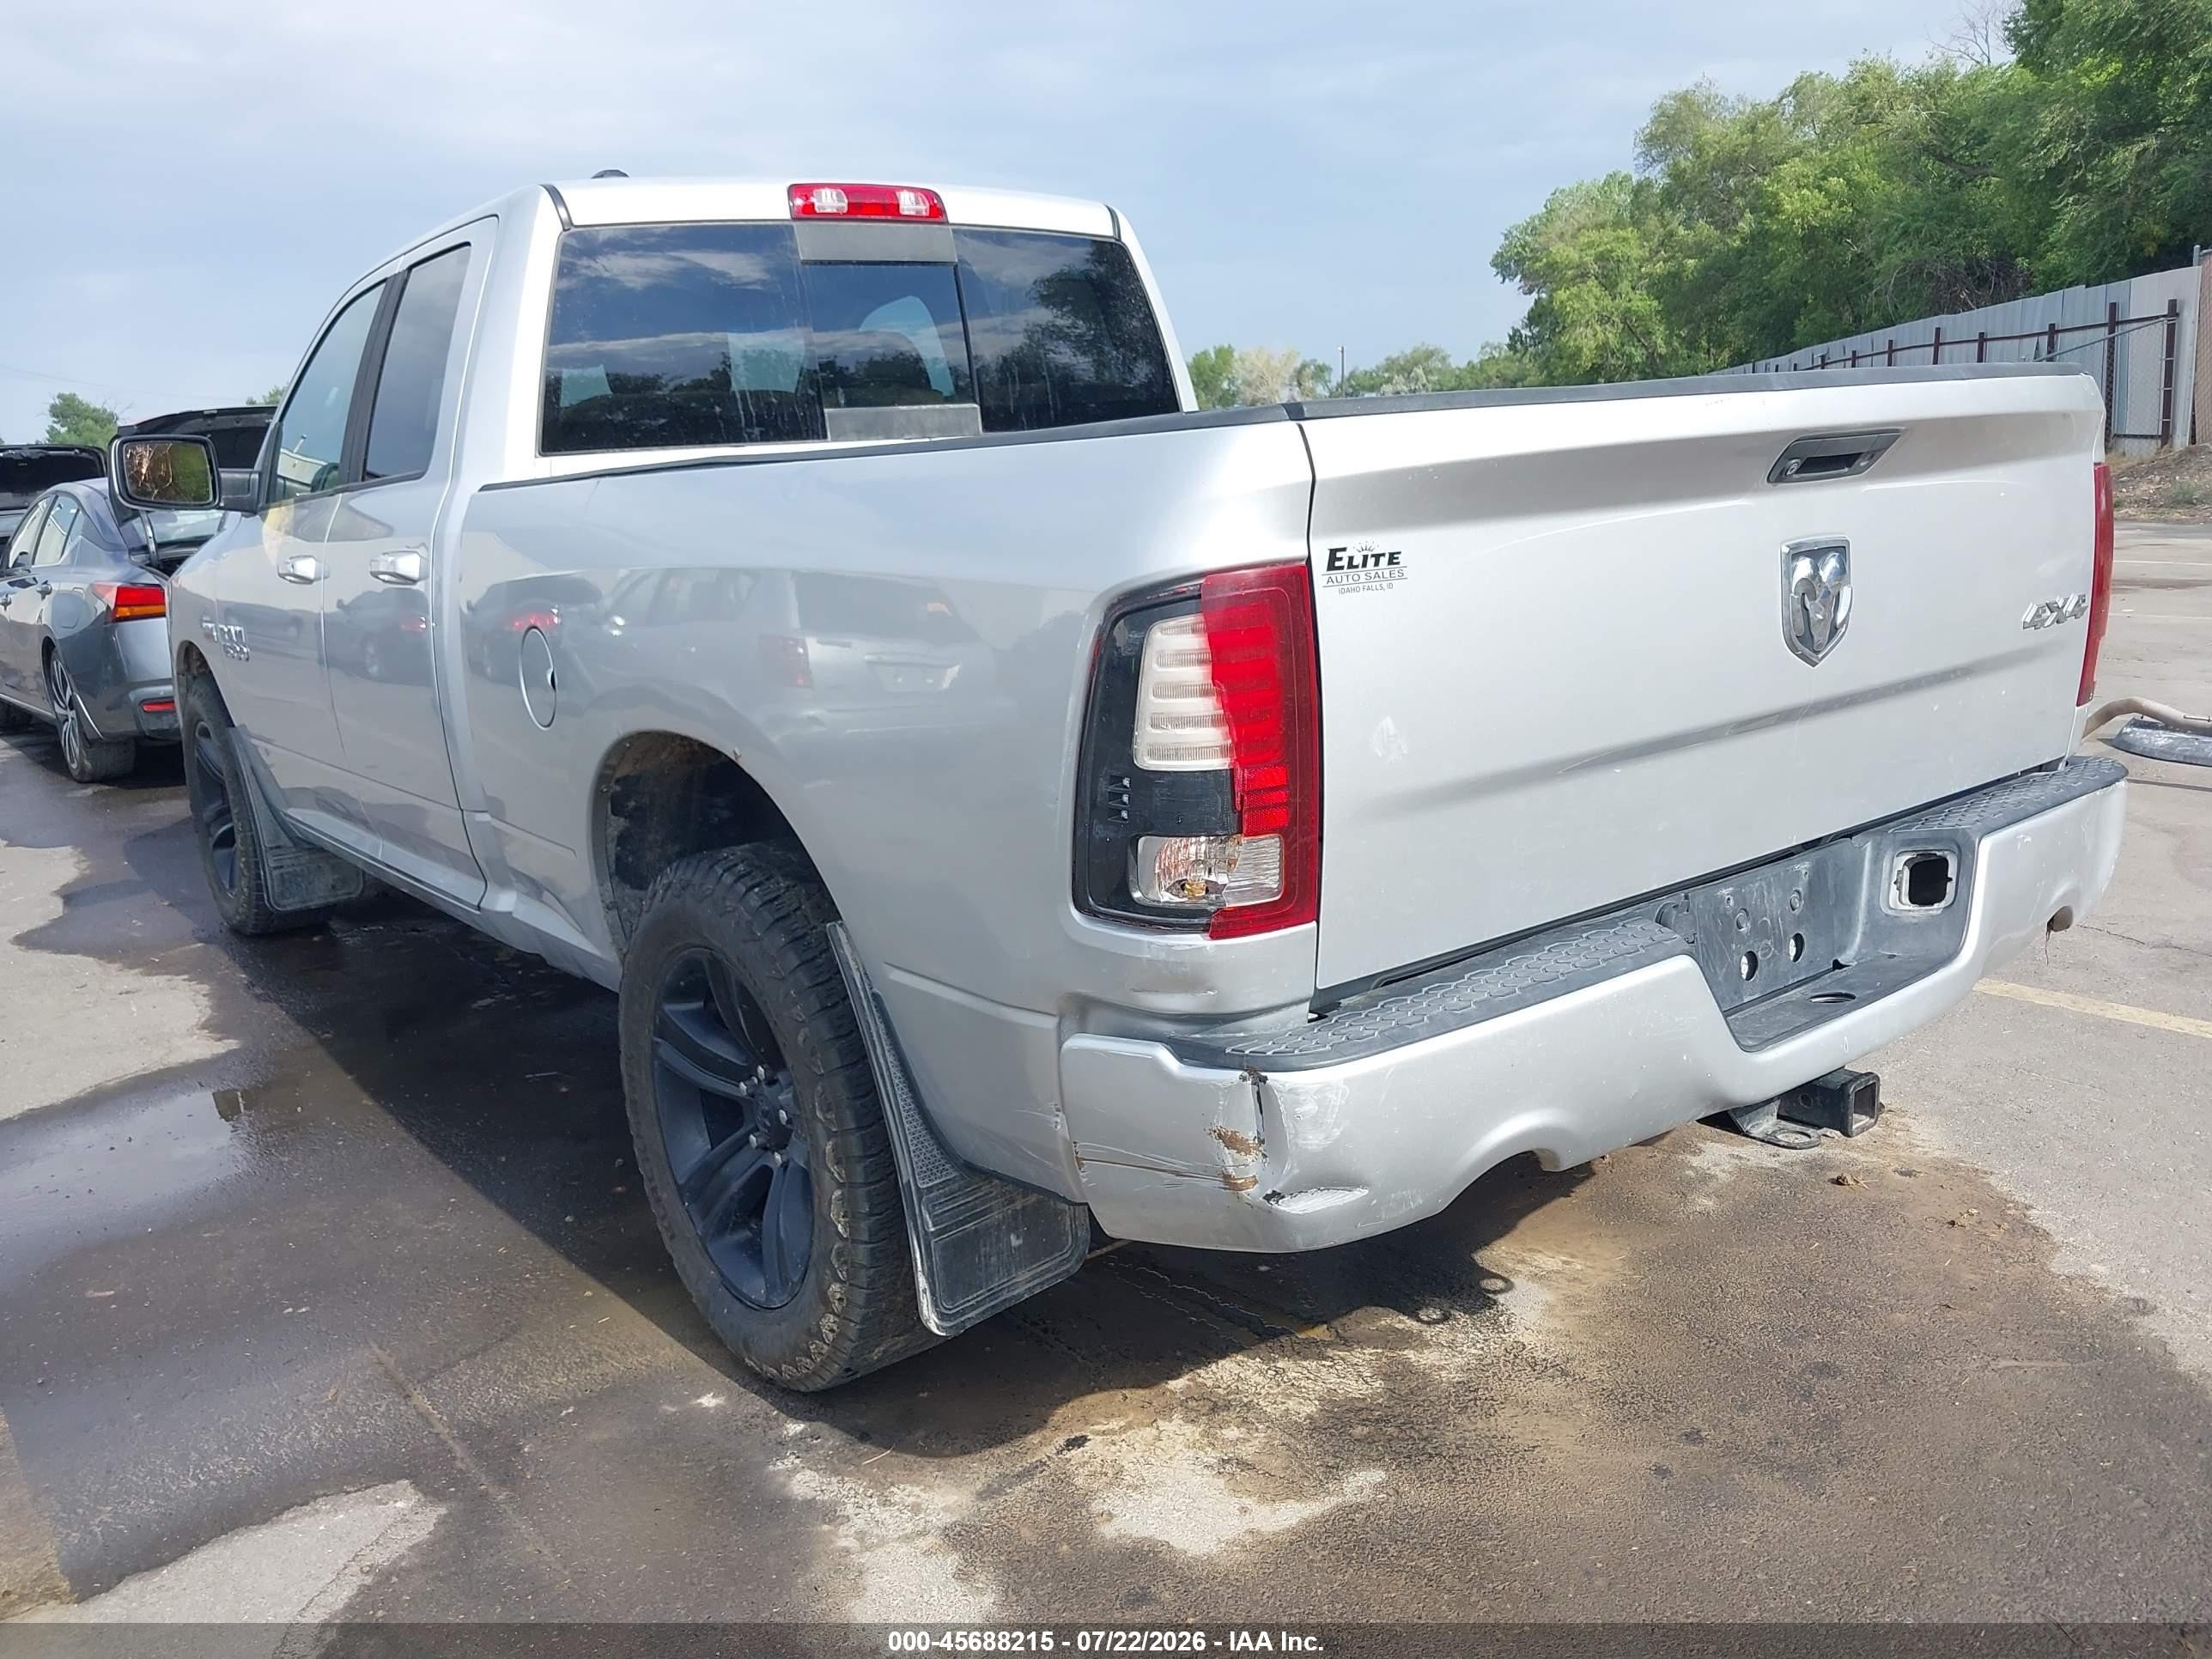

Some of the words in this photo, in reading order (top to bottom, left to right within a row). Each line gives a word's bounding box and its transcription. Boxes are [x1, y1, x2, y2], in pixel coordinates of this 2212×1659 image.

[1326, 573, 1361, 585] AUTO
[1364, 568, 1405, 581] SALES
[1339, 586, 1361, 595] IDAHO
